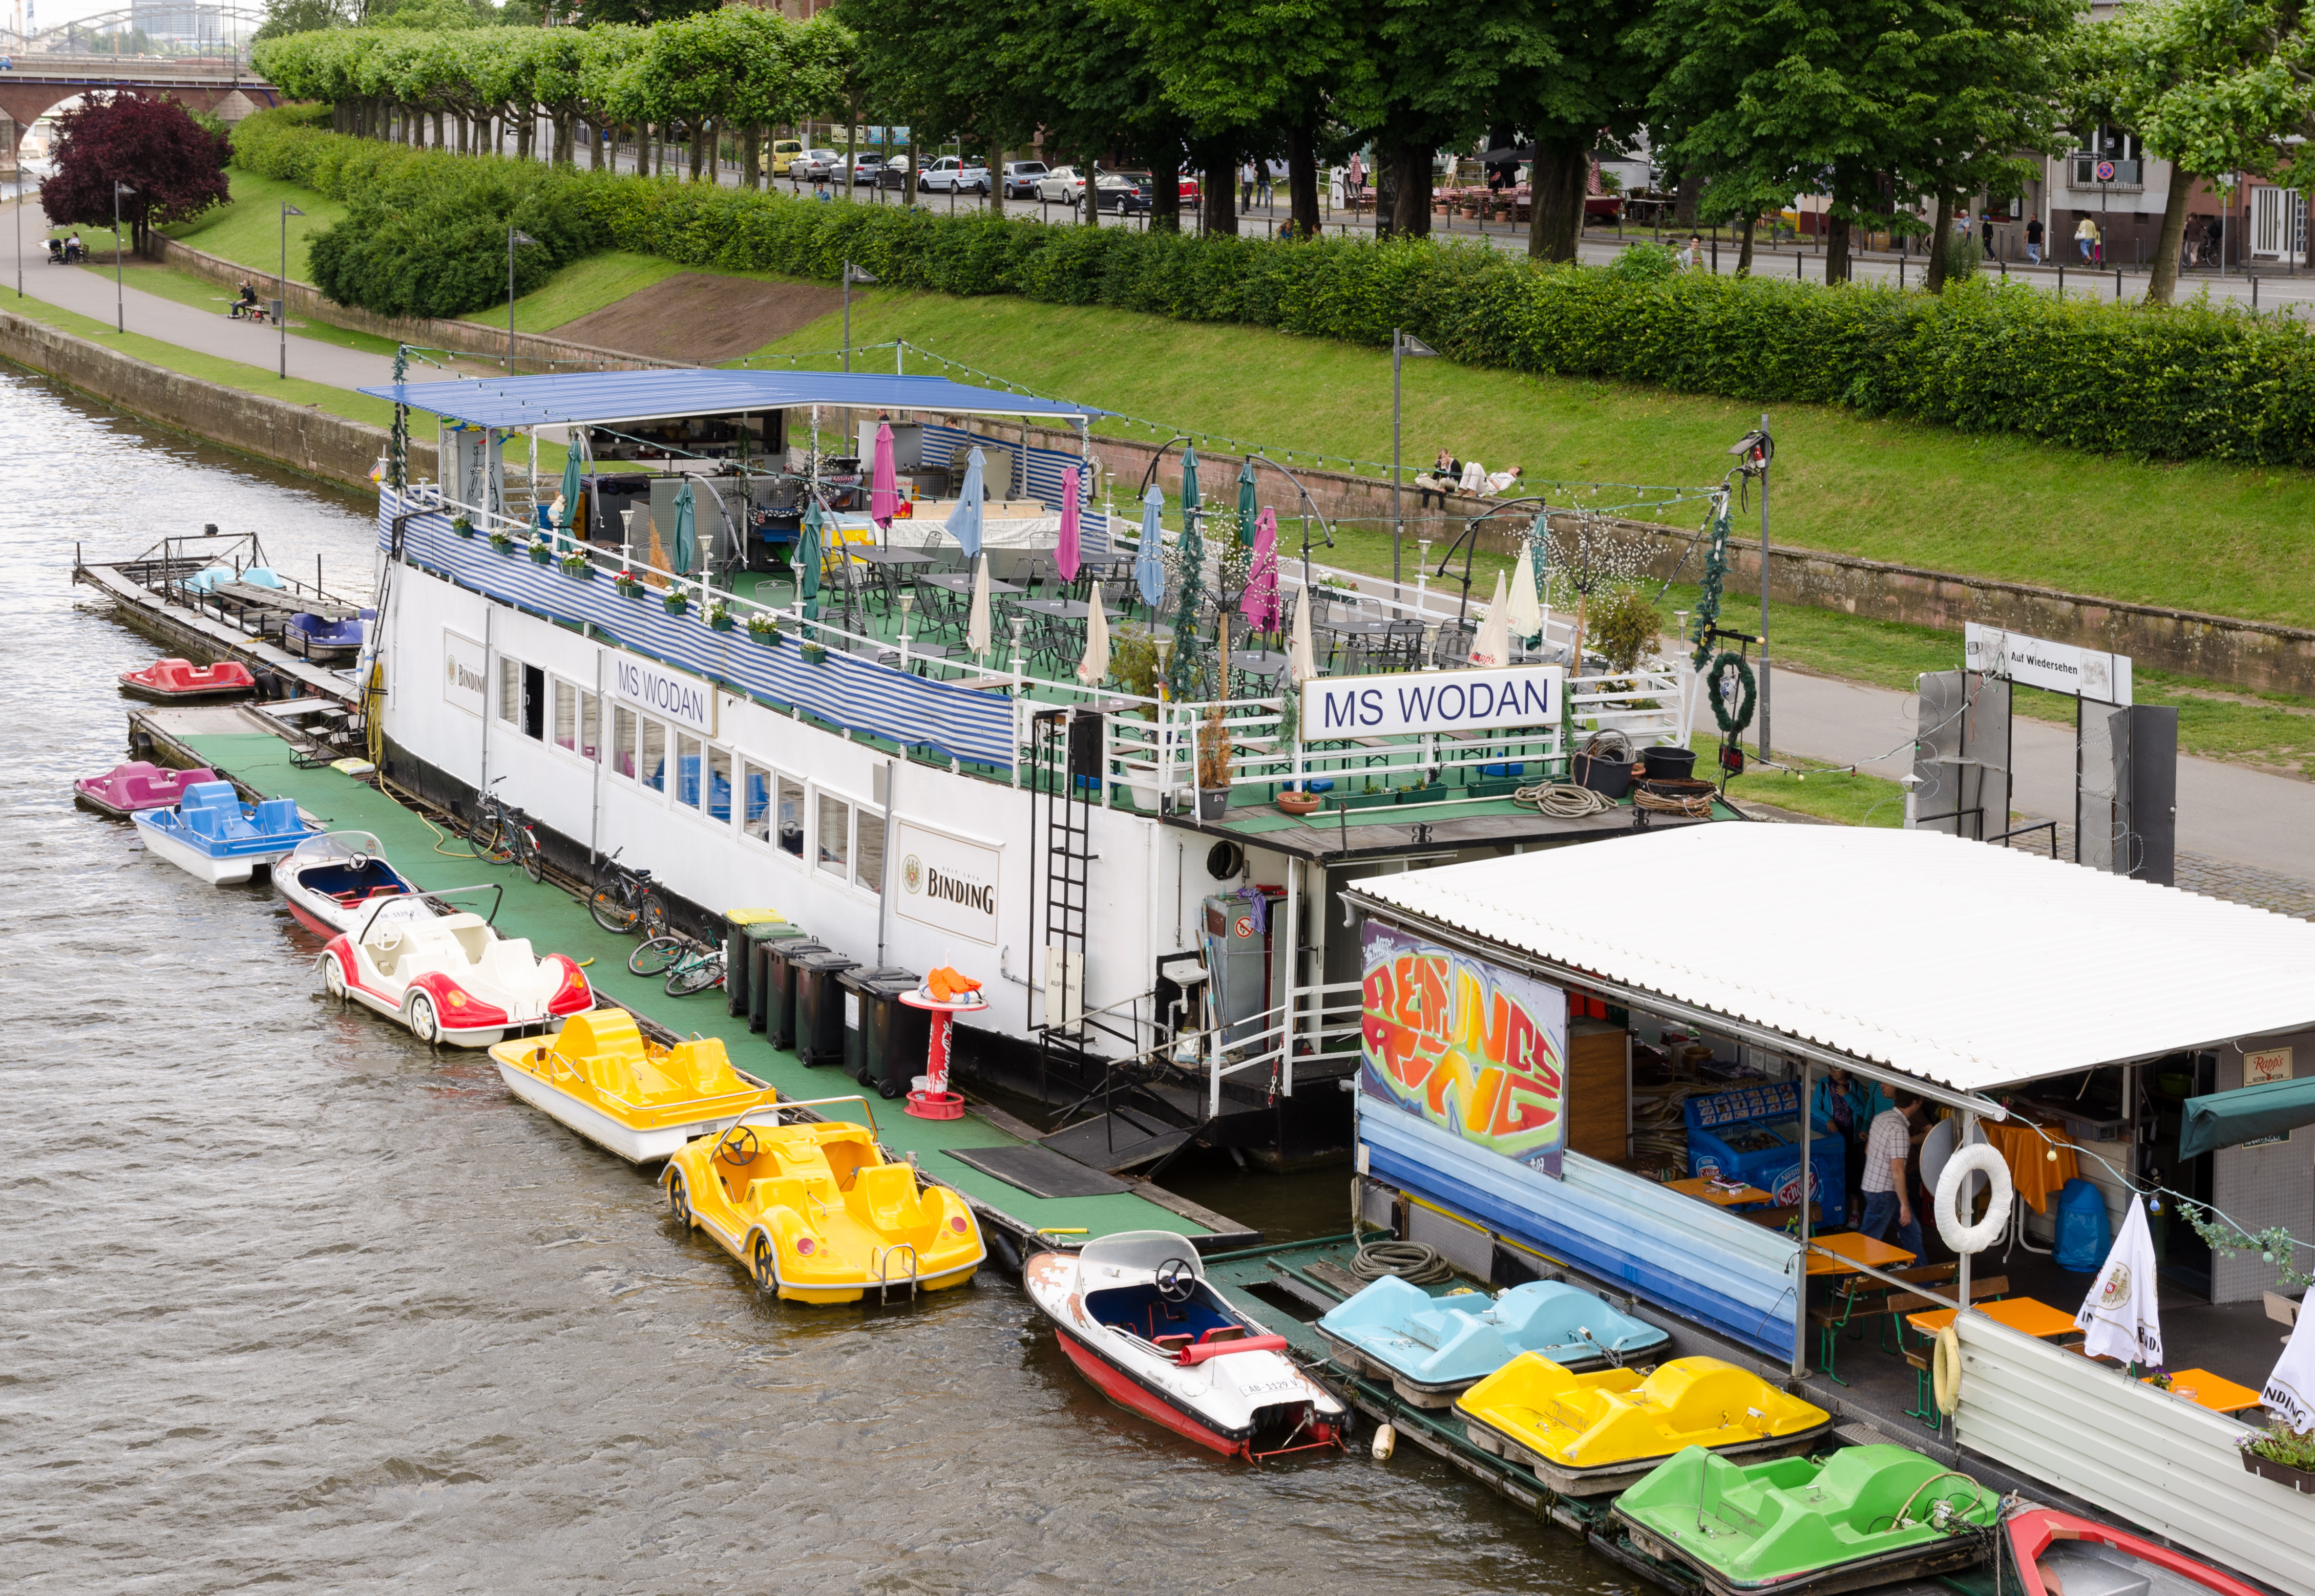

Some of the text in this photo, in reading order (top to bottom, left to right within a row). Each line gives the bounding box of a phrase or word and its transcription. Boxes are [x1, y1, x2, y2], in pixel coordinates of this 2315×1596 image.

[2011, 651, 2078, 675] Auf Wiedersehen
[618, 661, 704, 724] MS WODAN
[1324, 678, 1548, 728] MS WODAN
[942, 866, 980, 881] SEIT 1870
[928, 867, 994, 916] BINDING
[2254, 1055, 2284, 1074] Rapp's
[1248, 1381, 1289, 1393] AB-1129
